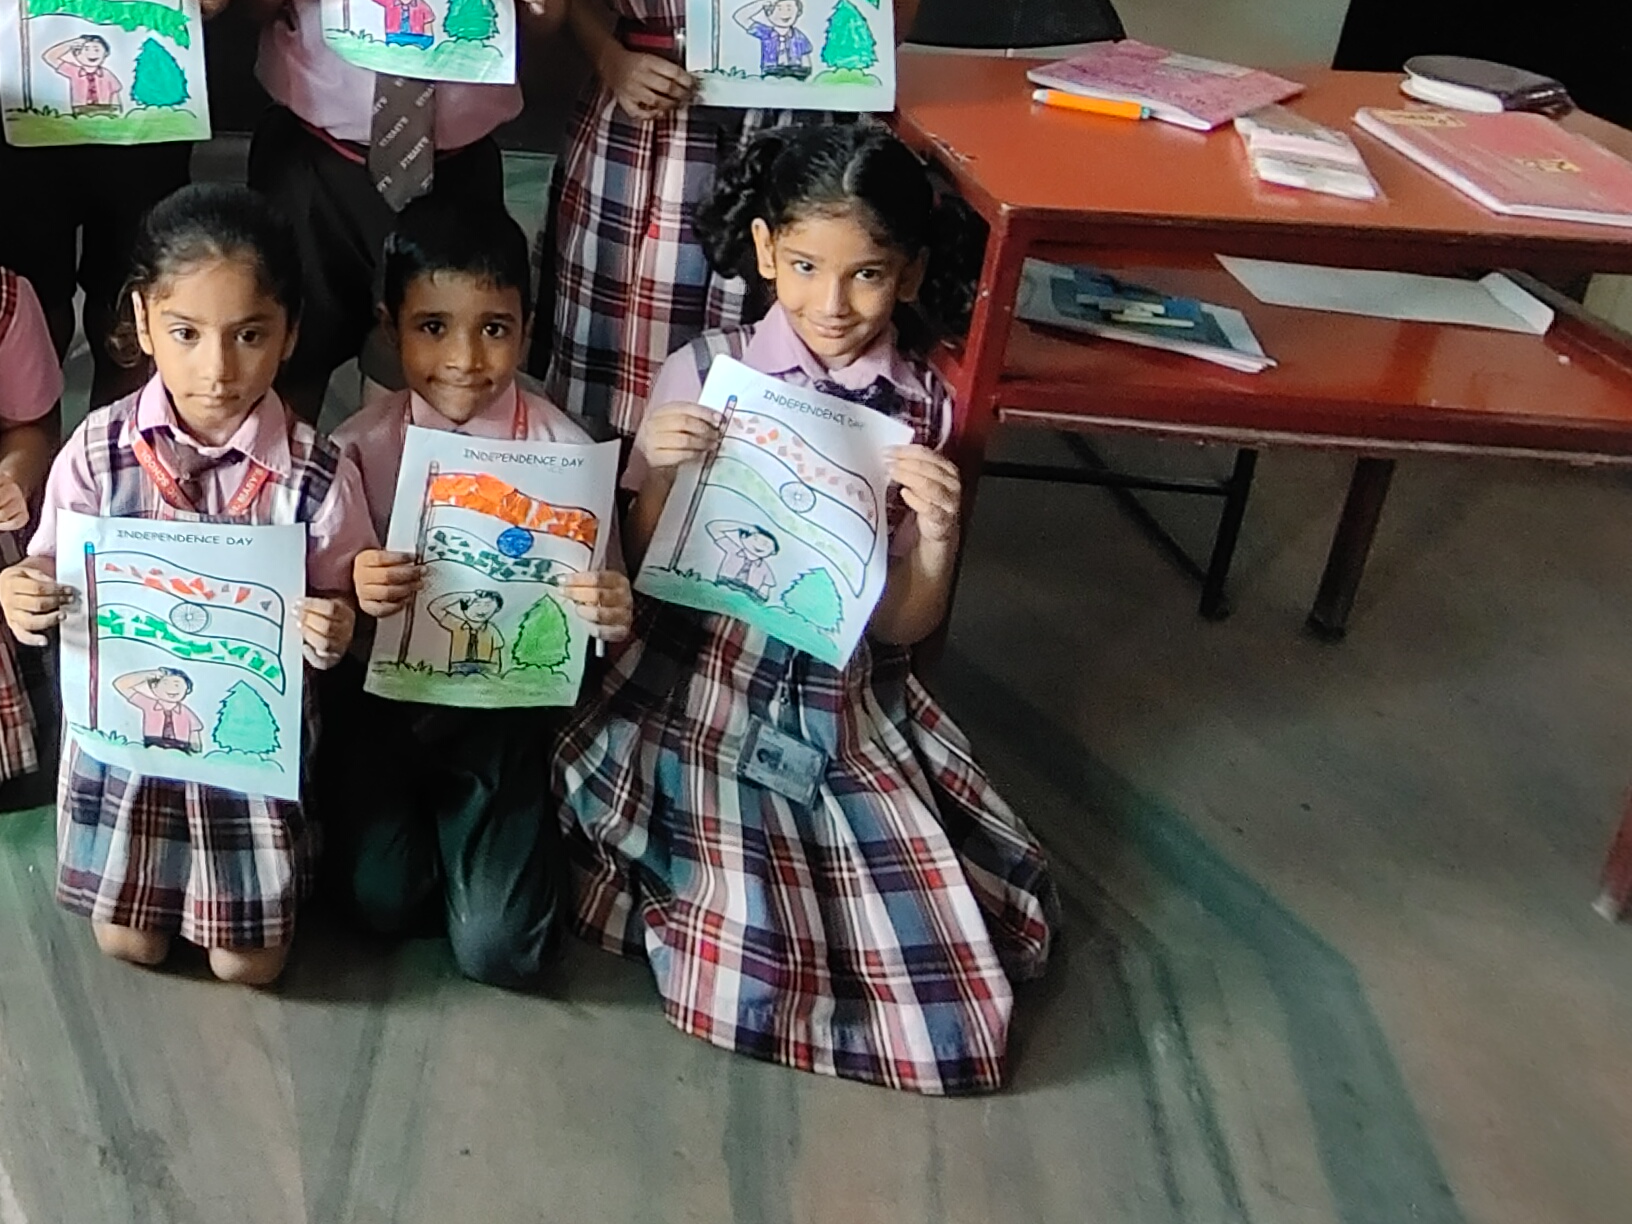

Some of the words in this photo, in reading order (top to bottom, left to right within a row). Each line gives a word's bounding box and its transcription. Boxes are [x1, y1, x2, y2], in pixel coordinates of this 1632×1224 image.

[464, 448, 557, 466] INDEPENDENCE
[561, 457, 585, 467] DAY
[141, 448, 170, 488] SCHOOL
[117, 529, 221, 545] INDEPENDENCE
[226, 537, 254, 546] DAY
